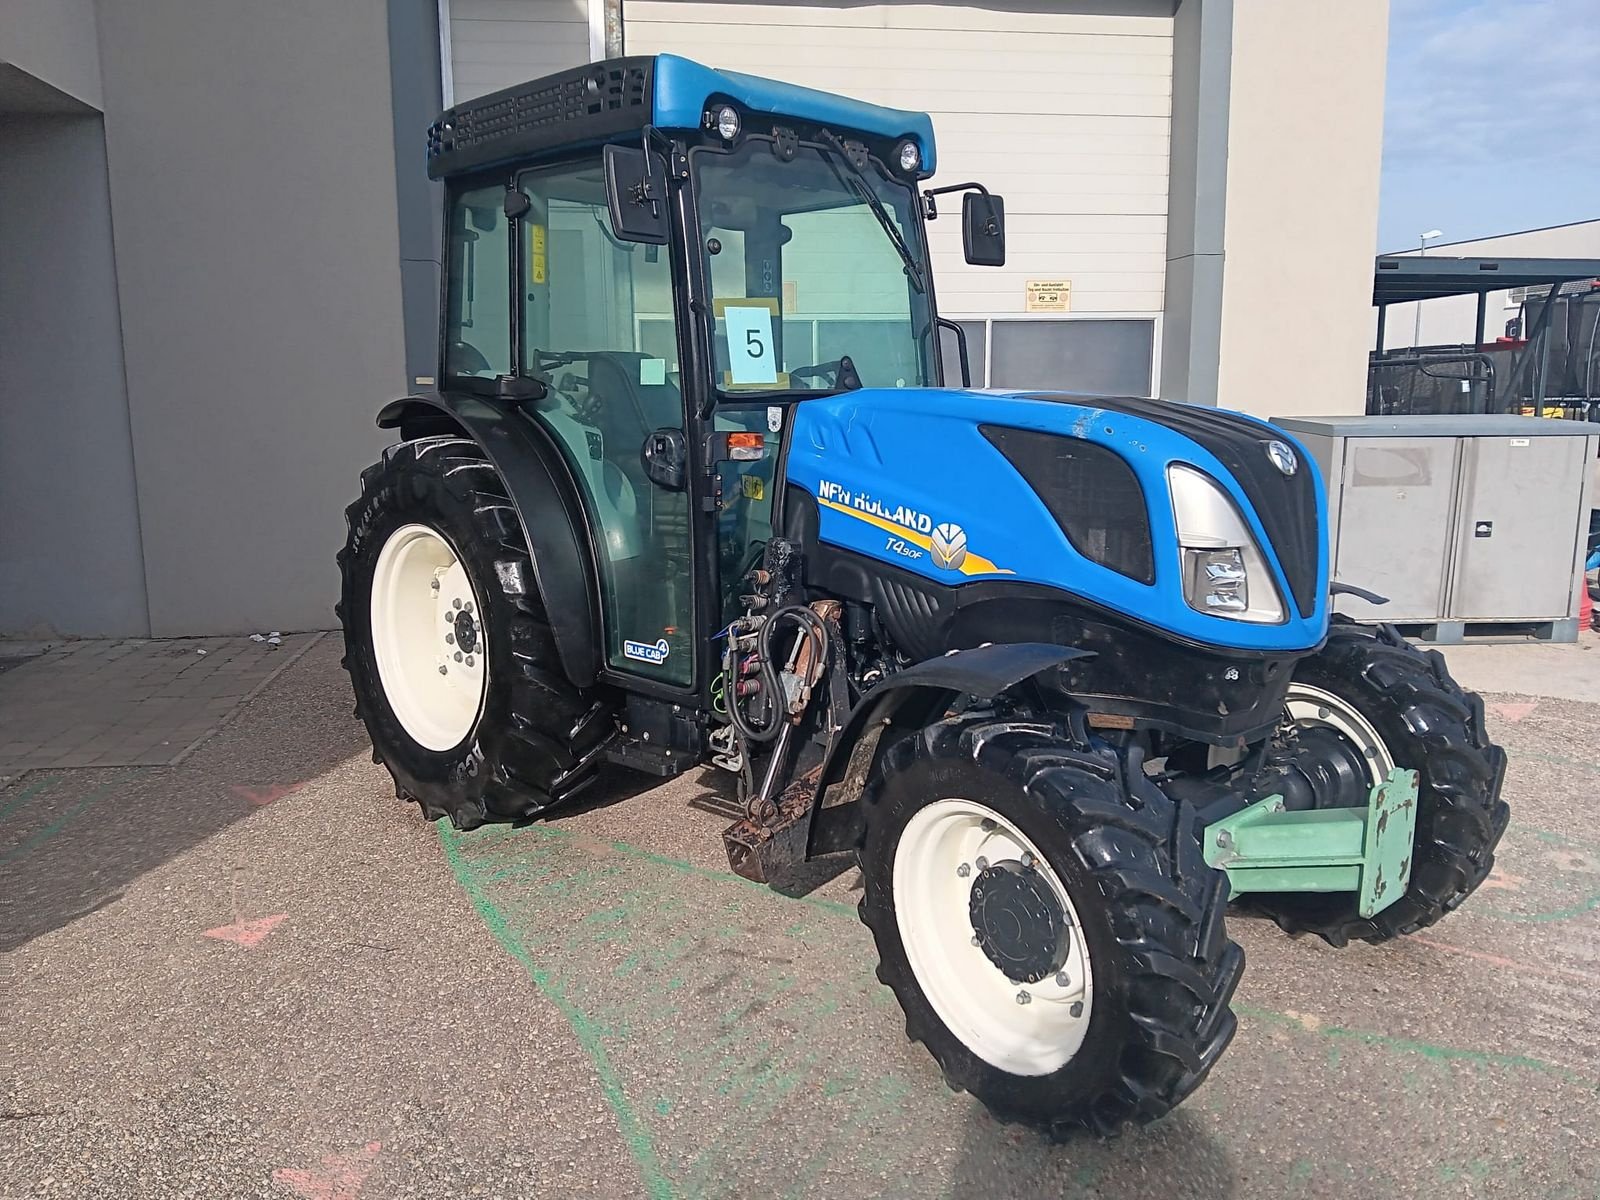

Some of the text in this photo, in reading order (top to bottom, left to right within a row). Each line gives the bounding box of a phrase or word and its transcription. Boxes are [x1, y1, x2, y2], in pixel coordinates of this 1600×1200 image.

[746, 329, 764, 358] 5
[626, 643, 667, 660] BLUE CAB 4
